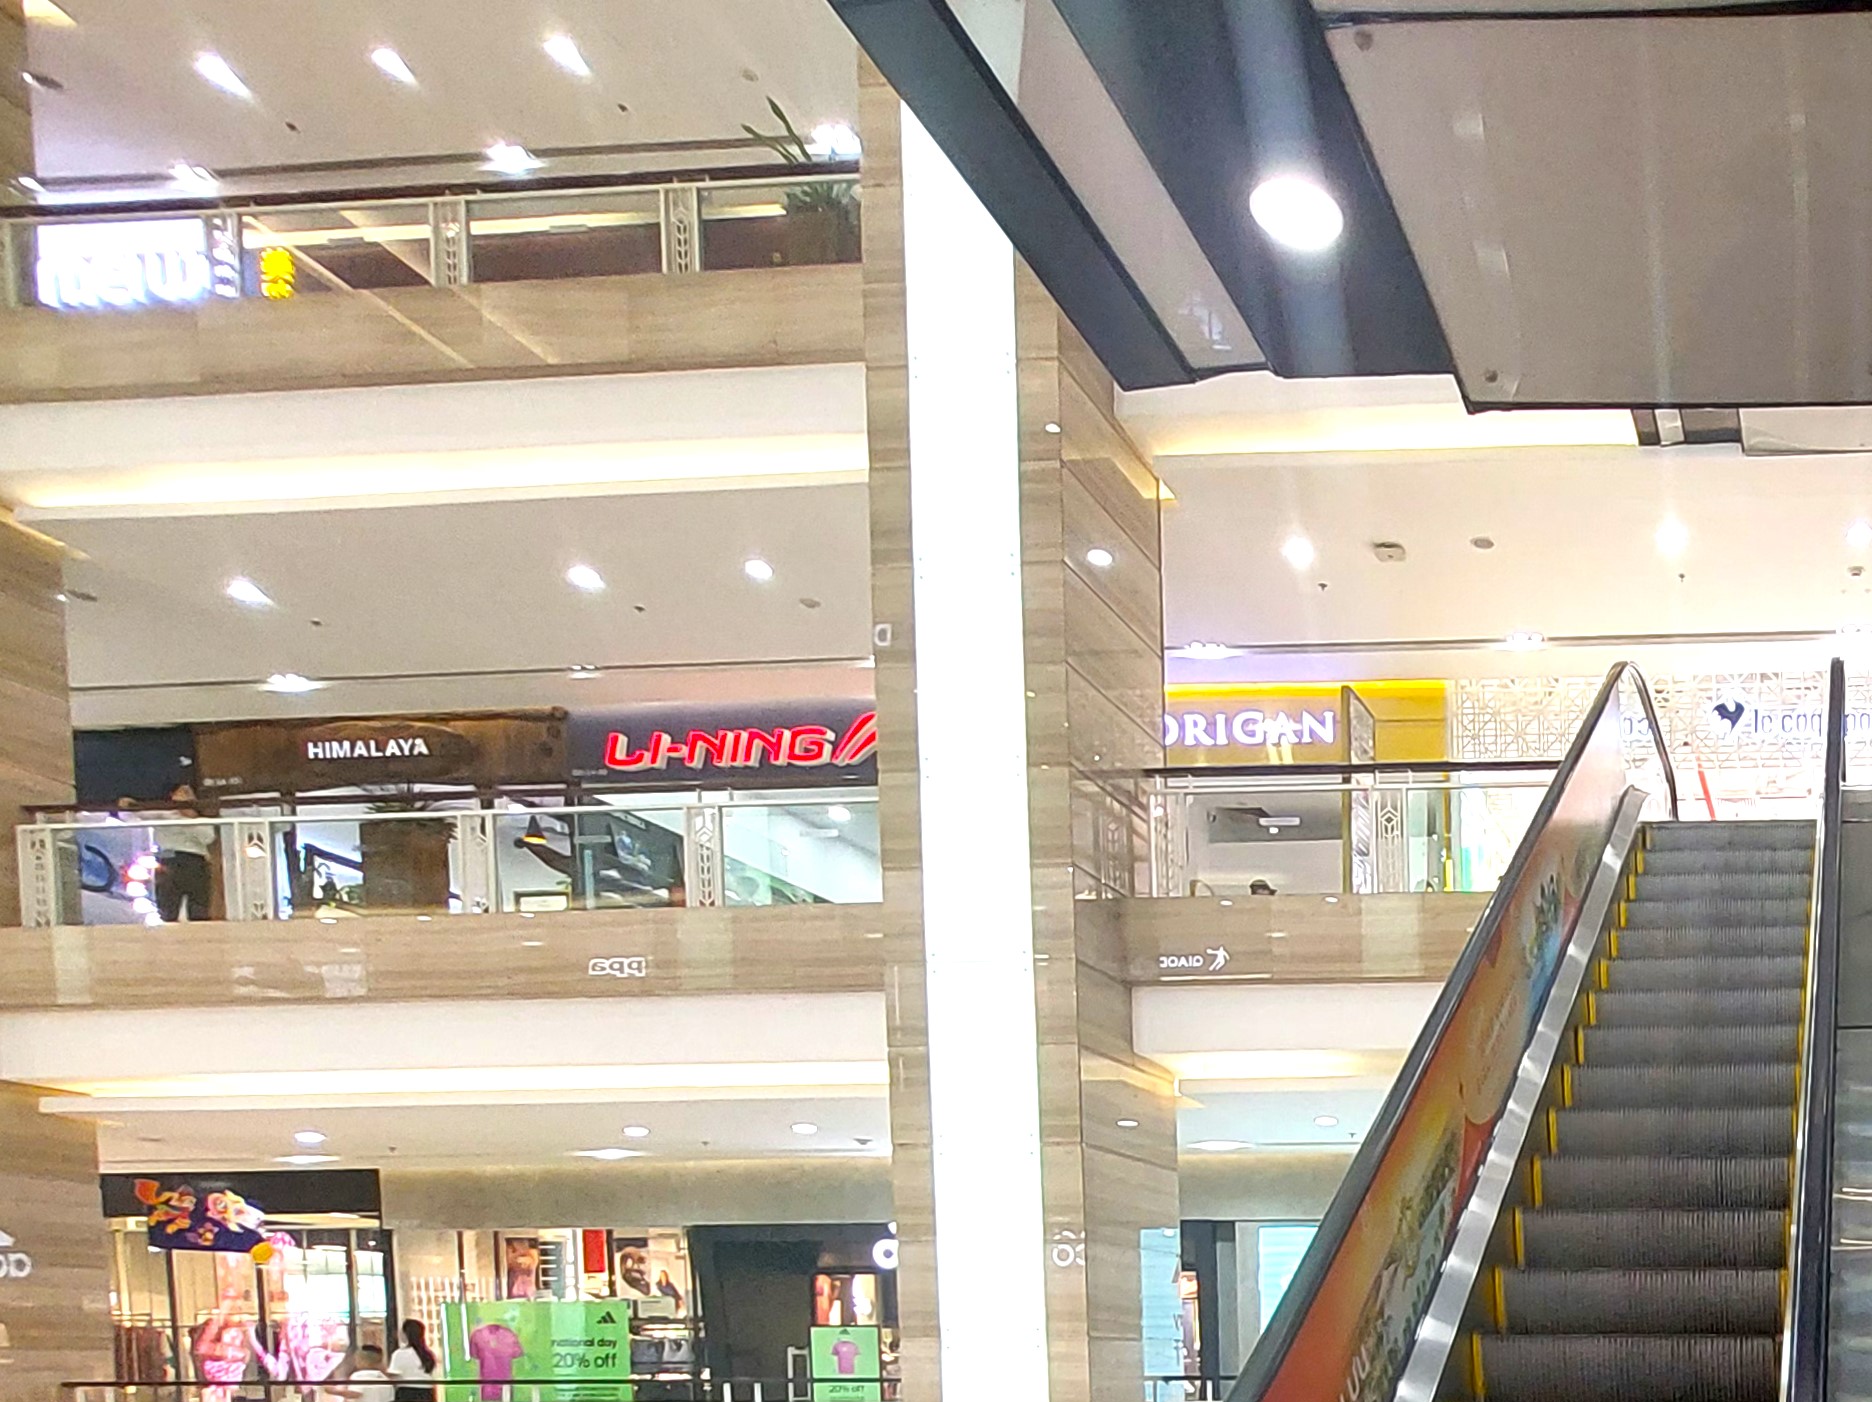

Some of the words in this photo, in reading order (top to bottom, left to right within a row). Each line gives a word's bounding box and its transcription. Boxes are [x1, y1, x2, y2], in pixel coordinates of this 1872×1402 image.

[307, 738, 430, 760] HIMALAYA
[603, 726, 836, 771] LI-NING
[597, 1337, 617, 1349] day
[553, 1353, 590, 1369] 20%
[594, 1352, 617, 1369] off
